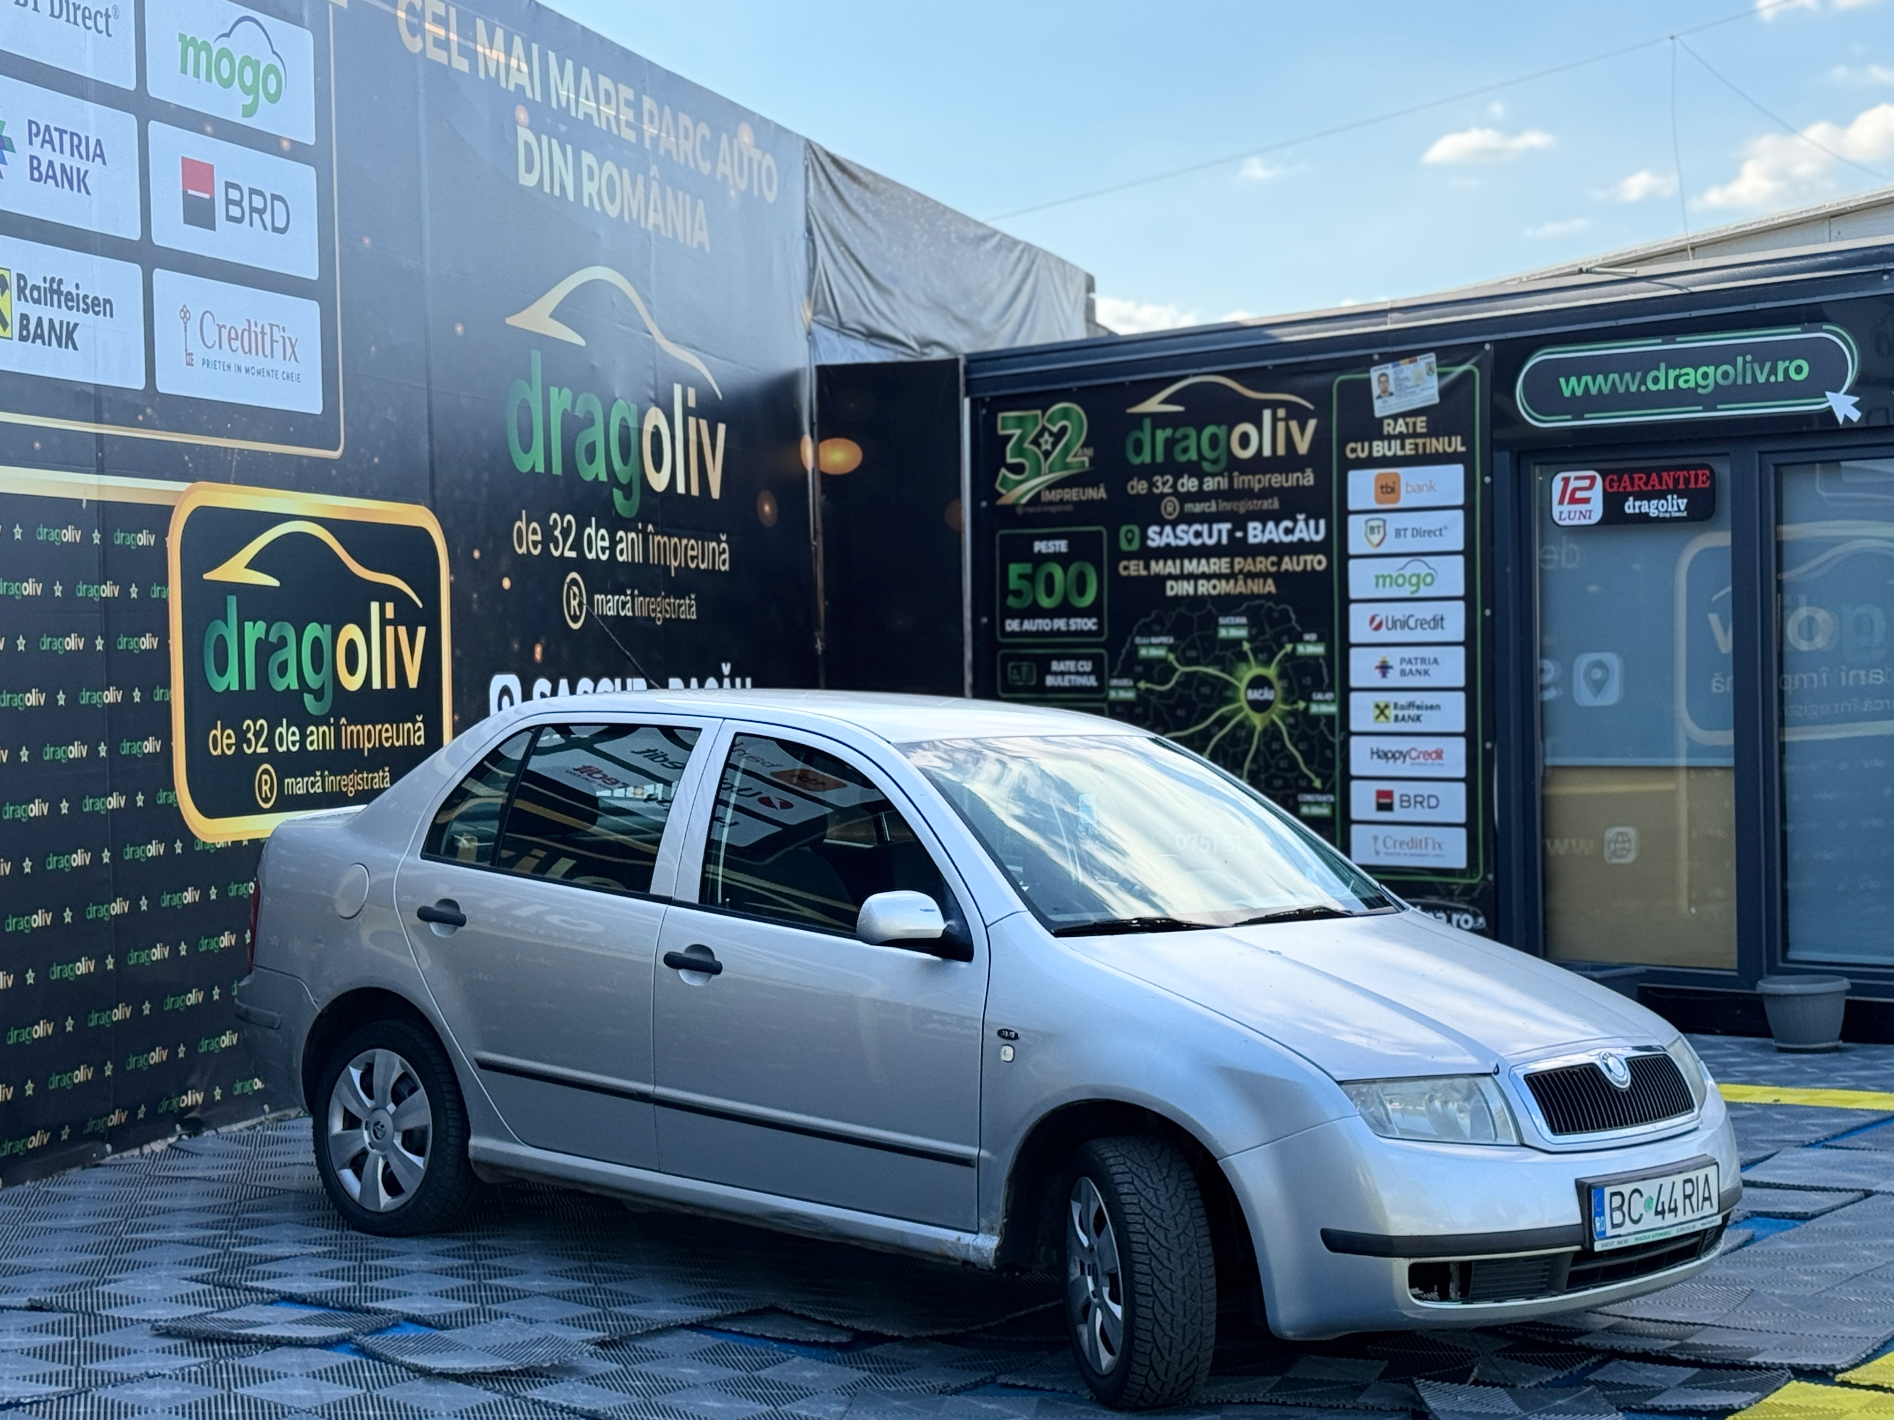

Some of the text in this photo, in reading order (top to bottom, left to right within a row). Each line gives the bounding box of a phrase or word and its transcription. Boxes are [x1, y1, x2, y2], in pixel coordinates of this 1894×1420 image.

[178, 32, 283, 118] mogo
[397, 0, 778, 204] CEL MAI MARE PARC AUTO
[27, 118, 107, 166] PATRIA
[29, 154, 91, 196] BANK
[516, 124, 710, 253] DIN ROMÂNIA
[224, 180, 291, 235] BRD
[16, 273, 115, 319] Raiffeisen
[18, 313, 79, 352] BANK
[200, 309, 300, 364] CreditFix
[202, 357, 232, 374] PRIETEN
[1558, 354, 1809, 396] www.dragoliv.ro
[506, 350, 726, 518] dragoliv
[1383, 416, 1427, 435] RATE
[995, 402, 1089, 496] 32
[1126, 408, 1318, 473] dragoliv
[1345, 436, 1466, 459] CU BULETINUL
[1127, 468, 1314, 494] de 32 de ani împreună
[1379, 480, 1437, 495] tbi bank
[1557, 475, 1597, 506] 12
[1604, 470, 1711, 492] GARANTIE
[1184, 498, 1217, 513] marcă
[1218, 497, 1280, 515] înregistrată
[1558, 510, 1593, 521] LUNI
[1624, 494, 1688, 517] dragoliv
[36, 524, 156, 549] dragoliv dragoliv
[1147, 523, 1232, 548] SASCUT
[1247, 514, 1326, 544] BACĂU
[1368, 524, 1382, 535] BT
[1394, 528, 1408, 539] BT
[513, 510, 730, 577] de 32 de ani împreună
[1033, 540, 1068, 554] PESTE
[1118, 554, 1327, 577] CEL MAI MARE PARC AUTO
[76, 580, 120, 601] dragoliv
[1006, 561, 1098, 609] 500
[1166, 574, 1277, 597] DIN ROMÂNIA
[1374, 571, 1436, 595] mogo
[594, 592, 632, 619] marcă
[634, 594, 697, 626] înregistrată
[1005, 618, 1098, 632] DE AUTO PE STOC
[1385, 613, 1445, 632] UniCredit
[40, 633, 158, 654] dragoliv dragoliv
[204, 595, 427, 716] dragoliv
[1051, 660, 1092, 672] RATE CU
[1399, 657, 1439, 667] PATRIA
[1399, 667, 1431, 678] BANK
[0, 689, 46, 710] dragoliv
[79, 686, 123, 708] dragoliv
[1393, 701, 1441, 713] Raiffeisen
[1393, 713, 1423, 724] BANK
[209, 714, 425, 757] de 32 de ani împreună
[42, 737, 162, 763] dragoliv dragoliv
[1370, 746, 1444, 764] HappyCredit
[284, 772, 323, 796] marcă
[324, 768, 391, 797] înregistrată
[2, 799, 49, 822] dragoliv
[82, 791, 126, 814] dragoliv
[1399, 794, 1440, 810] BRD
[46, 849, 91, 872] dragoliv
[123, 840, 165, 862] dragoliv
[1383, 835, 1444, 851] CreditFix
[5, 909, 52, 933] dragoliv
[86, 897, 130, 920] dragoliv
[160, 886, 200, 909] dragoliv
[50, 931, 236, 980] dragoliv dragoliv dragoliv
[6, 1019, 54, 1045] dragoliv
[87, 1003, 132, 1027] dragoliv
[163, 988, 204, 1011] dragoliv
[48, 1030, 238, 1090] dragoliv dragoliv dragoliv
[83, 1108, 128, 1134] dragoliv
[157, 1089, 204, 1113] dragoliv
[1609, 1173, 1713, 1230] BC 44 RIA
